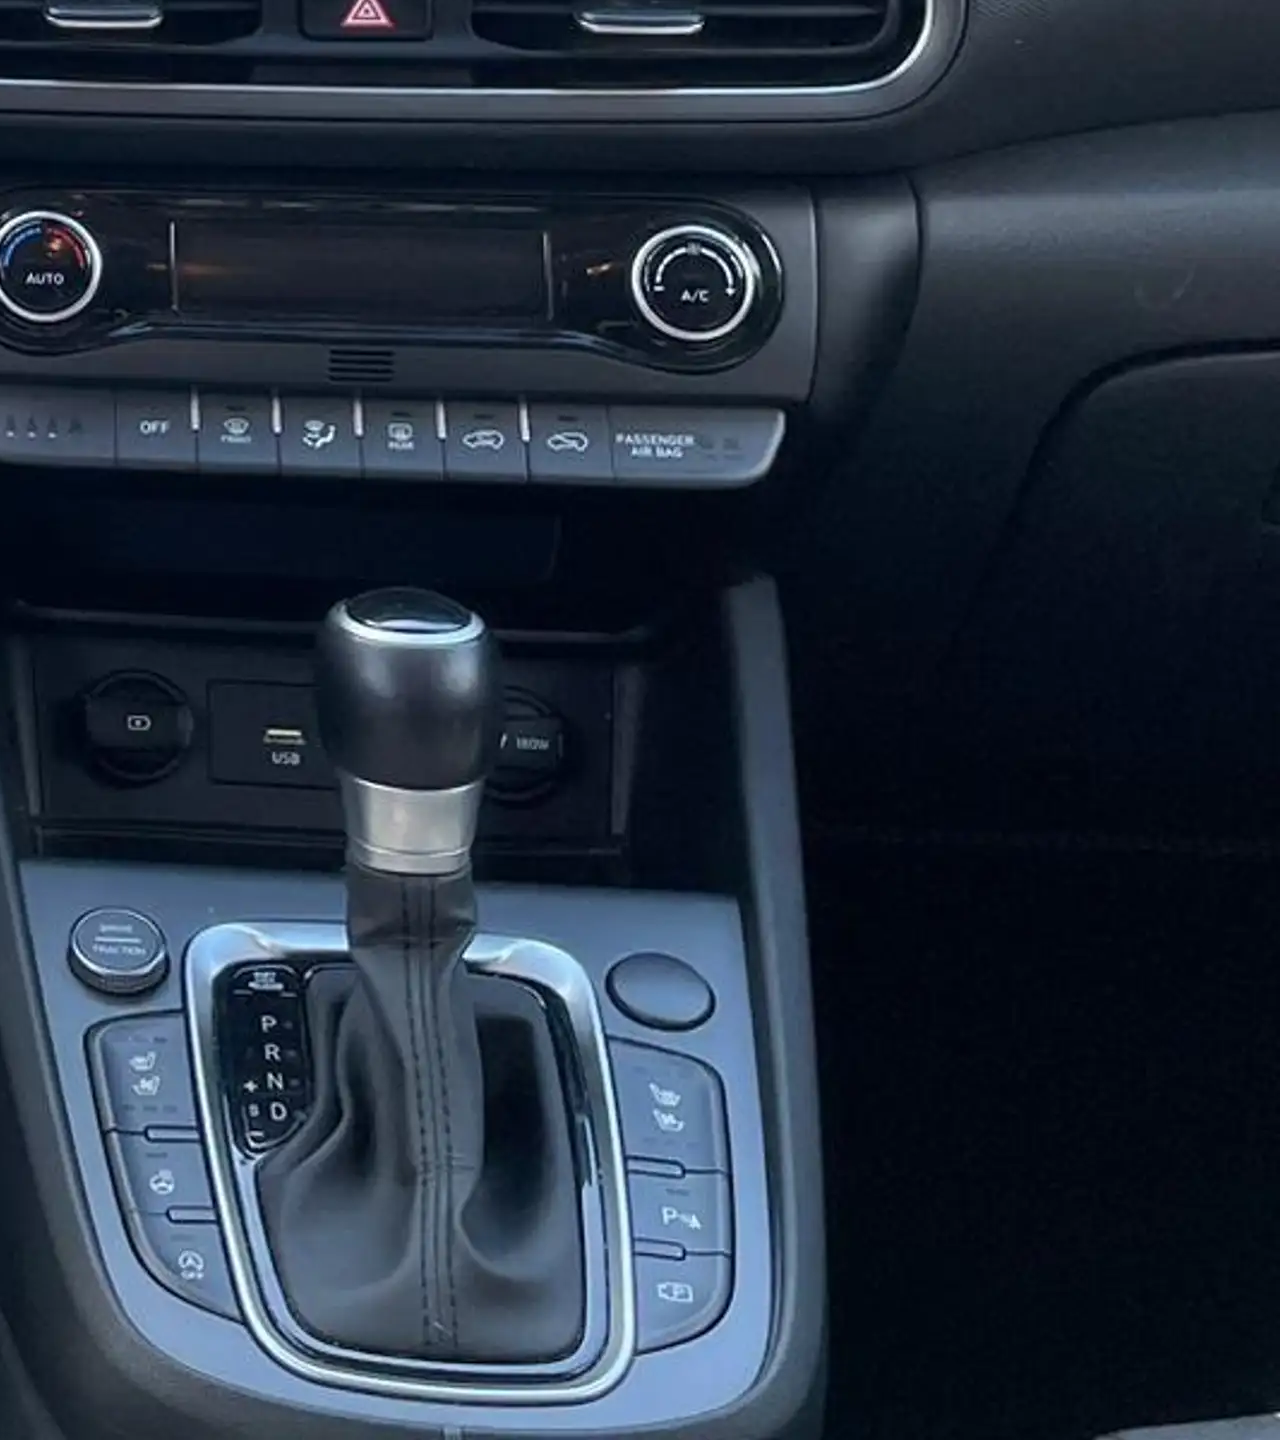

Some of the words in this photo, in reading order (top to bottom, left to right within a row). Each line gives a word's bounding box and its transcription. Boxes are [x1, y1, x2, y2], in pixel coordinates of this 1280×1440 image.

[25, 272, 64, 286] AUTO
[681, 290, 710, 303] A/C
[140, 419, 170, 434] OFF
[616, 432, 694, 445] PASSENGER
[631, 445, 653, 458] AIR
[655, 446, 684, 459] BAG
[271, 750, 300, 765] USB
[261, 1016, 278, 1031] P
[264, 1044, 281, 1061] R
[267, 1073, 284, 1090] N
[271, 1101, 288, 1121] D
